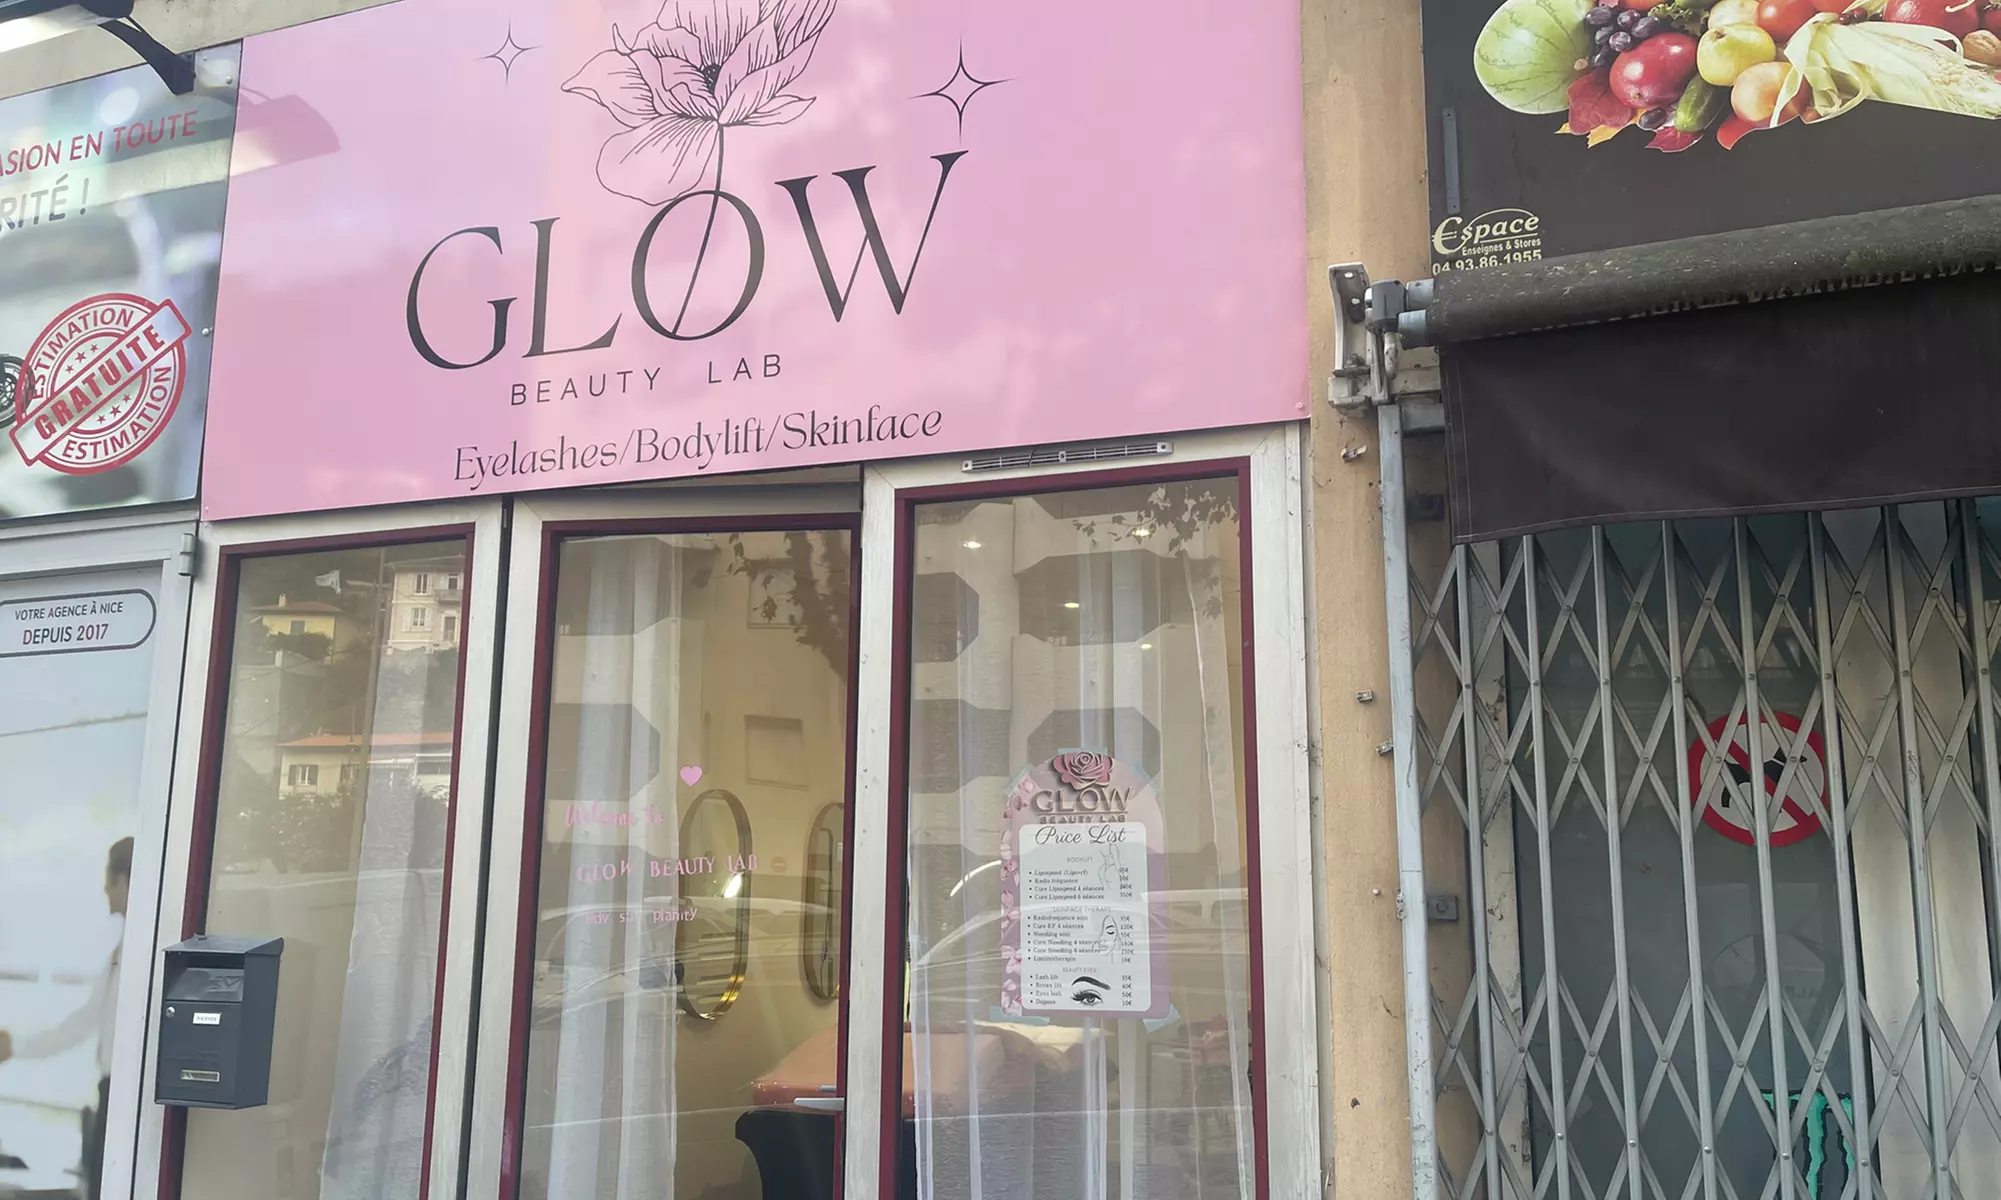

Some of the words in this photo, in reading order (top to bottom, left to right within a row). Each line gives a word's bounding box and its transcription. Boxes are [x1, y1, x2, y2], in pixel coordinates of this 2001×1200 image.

[0, 140, 62, 177] SION
[69, 131, 103, 161] EN
[112, 110, 198, 154] TOUTE
[406, 150, 969, 370] GLOW
[1462, 243, 1504, 256] Enseignes
[1505, 241, 1512, 250] &
[1514, 238, 1541, 249] Stores
[32, 307, 134, 400] ESTIMATION
[34, 324, 165, 440] GRATUITE
[511, 367, 661, 407] BEAUTY
[708, 353, 782, 385] LAB
[62, 366, 172, 460] ESTIMATION
[454, 404, 942, 491] Eyelashes/Bodylift/Skinface
[15, 608, 45, 621] VOTRE
[47, 604, 87, 618] AGENCE
[90, 600, 97, 615] À
[100, 601, 124, 614] NICE
[23, 626, 72, 645] DEPUIS
[76, 624, 109, 641] 2017
[1032, 787, 1132, 812] GLOW
[1035, 825, 1082, 845] Price
[1088, 824, 1127, 844] List
[1040, 815, 1093, 824] BEAUTY
[1100, 814, 1126, 823] LAB
[577, 860, 632, 885] GLOW
[649, 856, 716, 877] BEAUTY
[728, 854, 758, 875] LAB
[652, 908, 698, 923] planity
